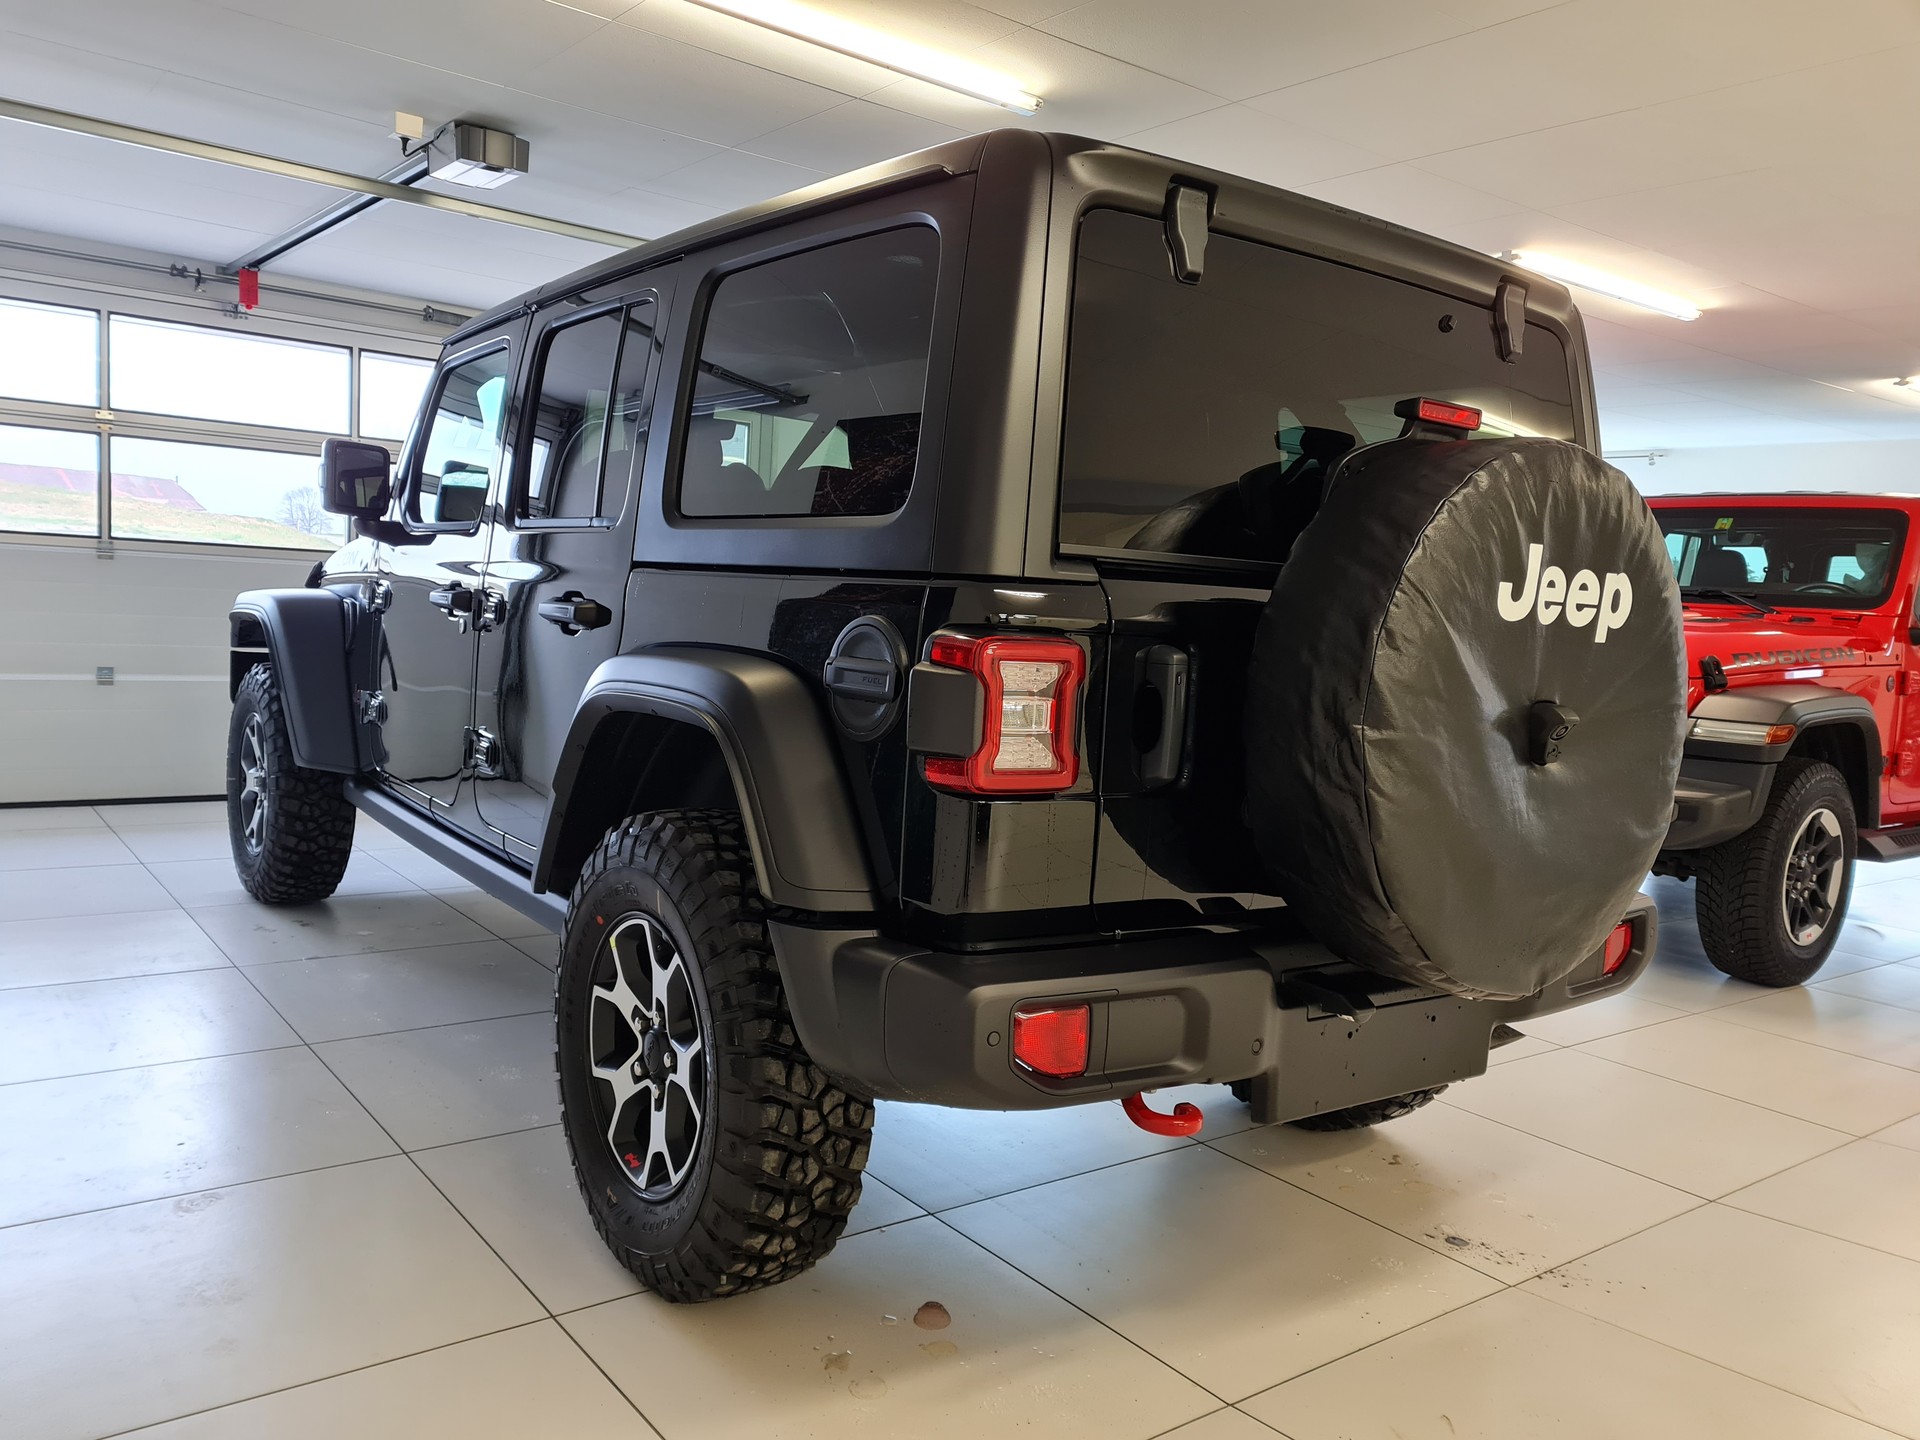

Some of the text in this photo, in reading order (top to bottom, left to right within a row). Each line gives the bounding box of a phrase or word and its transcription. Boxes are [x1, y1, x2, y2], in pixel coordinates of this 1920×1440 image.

[1497, 543, 1633, 644] Jeep
[1731, 646, 1856, 668] RUBICON
[862, 675, 883, 686] FUEL
